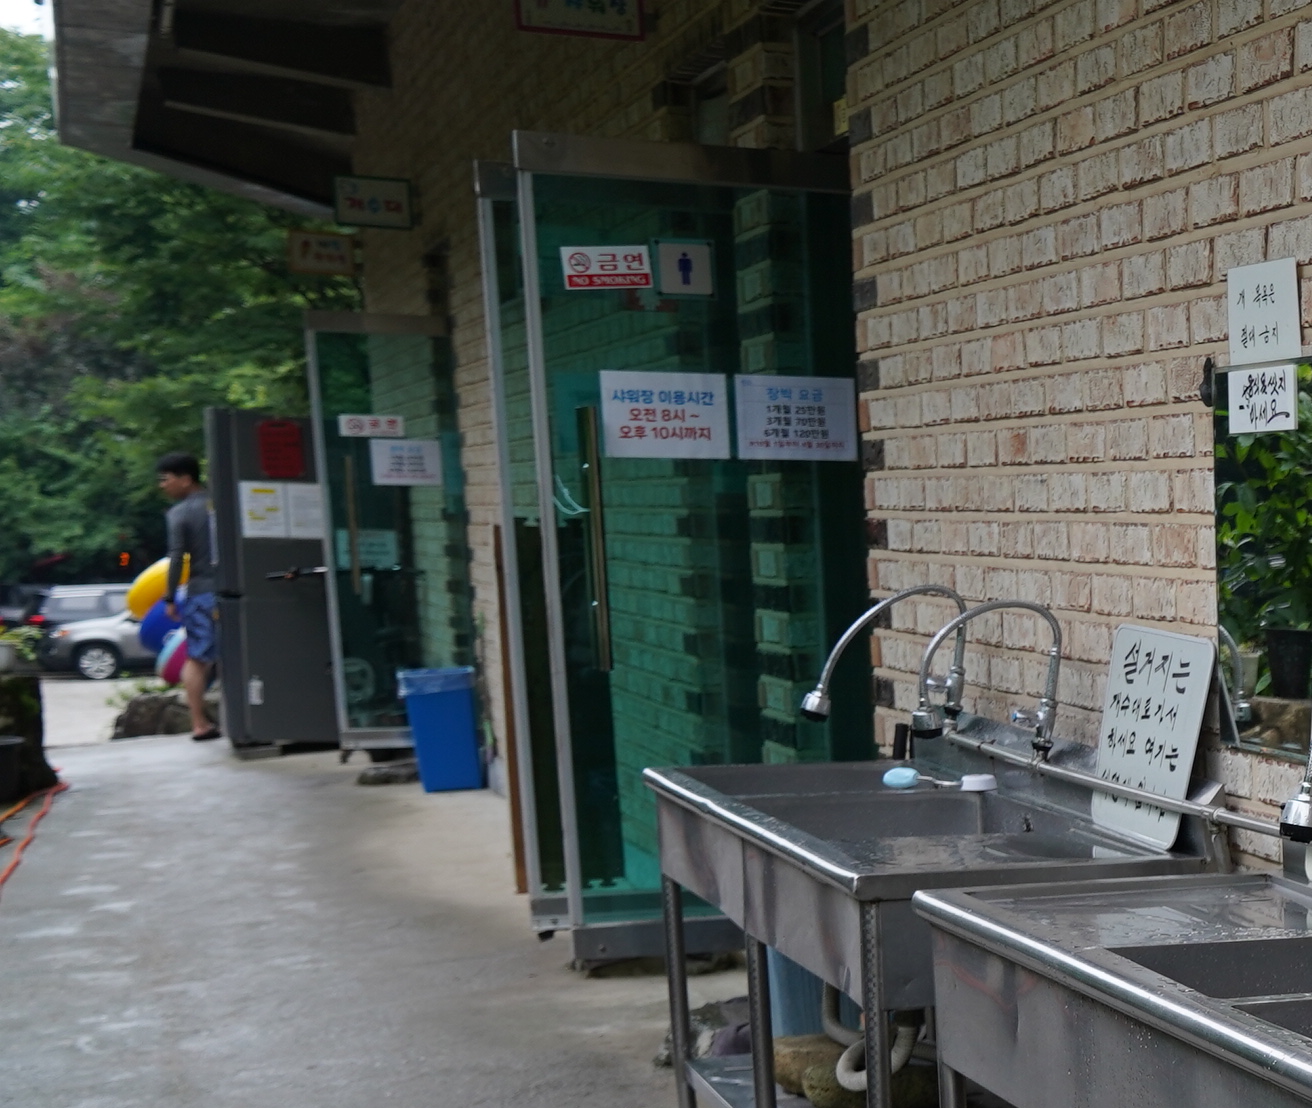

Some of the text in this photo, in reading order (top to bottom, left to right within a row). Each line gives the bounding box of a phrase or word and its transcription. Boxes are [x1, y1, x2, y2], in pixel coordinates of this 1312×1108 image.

[597, 252, 646, 271] 금연
[571, 275, 646, 286] NO SMOKING
[1258, 320, 1279, 346] 금지
[658, 389, 715, 406] 이용시간
[798, 389, 824, 403] 요금
[628, 407, 658, 423] 오전
[661, 408, 687, 423] 8시
[1250, 398, 1291, 431] 마세요
[618, 425, 712, 441] 오후 10시까지
[1123, 638, 1191, 694] 설거지는
[1109, 692, 1151, 722] 개수대로
[1107, 726, 1180, 773] 하세요 여기는
